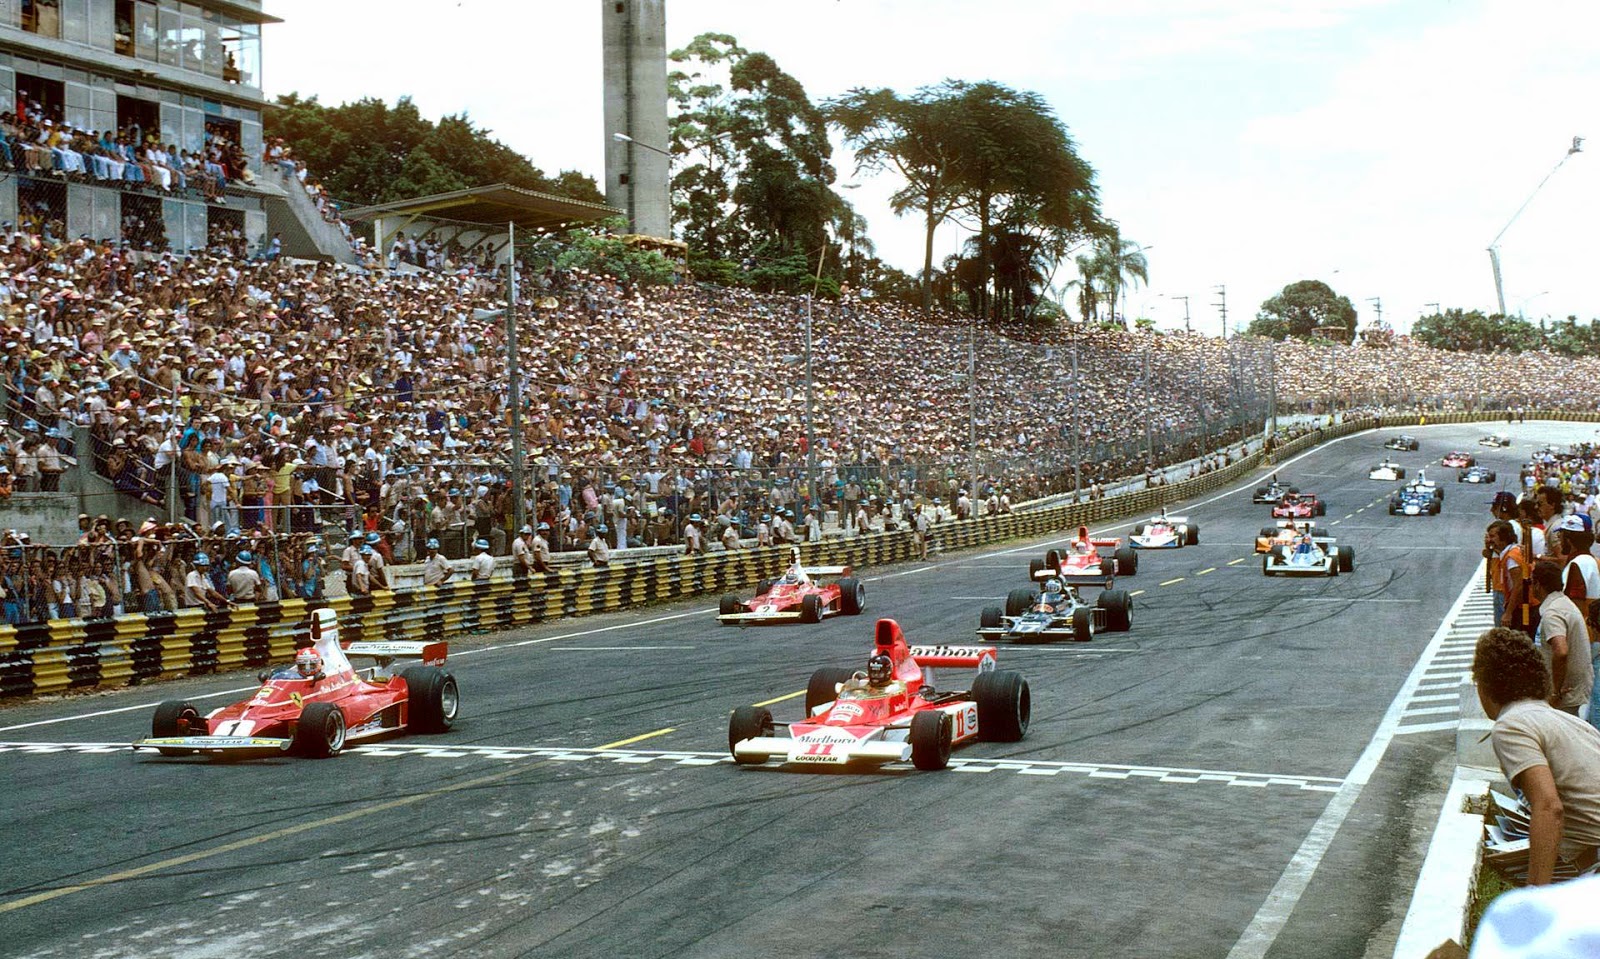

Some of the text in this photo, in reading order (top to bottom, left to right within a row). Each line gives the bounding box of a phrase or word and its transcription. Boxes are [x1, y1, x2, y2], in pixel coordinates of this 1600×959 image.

[907, 645, 981, 657] arlbor
[228, 721, 241, 736] 1
[956, 710, 965, 737] 11
[799, 735, 856, 743] Marlboro
[804, 743, 834, 755] 11
